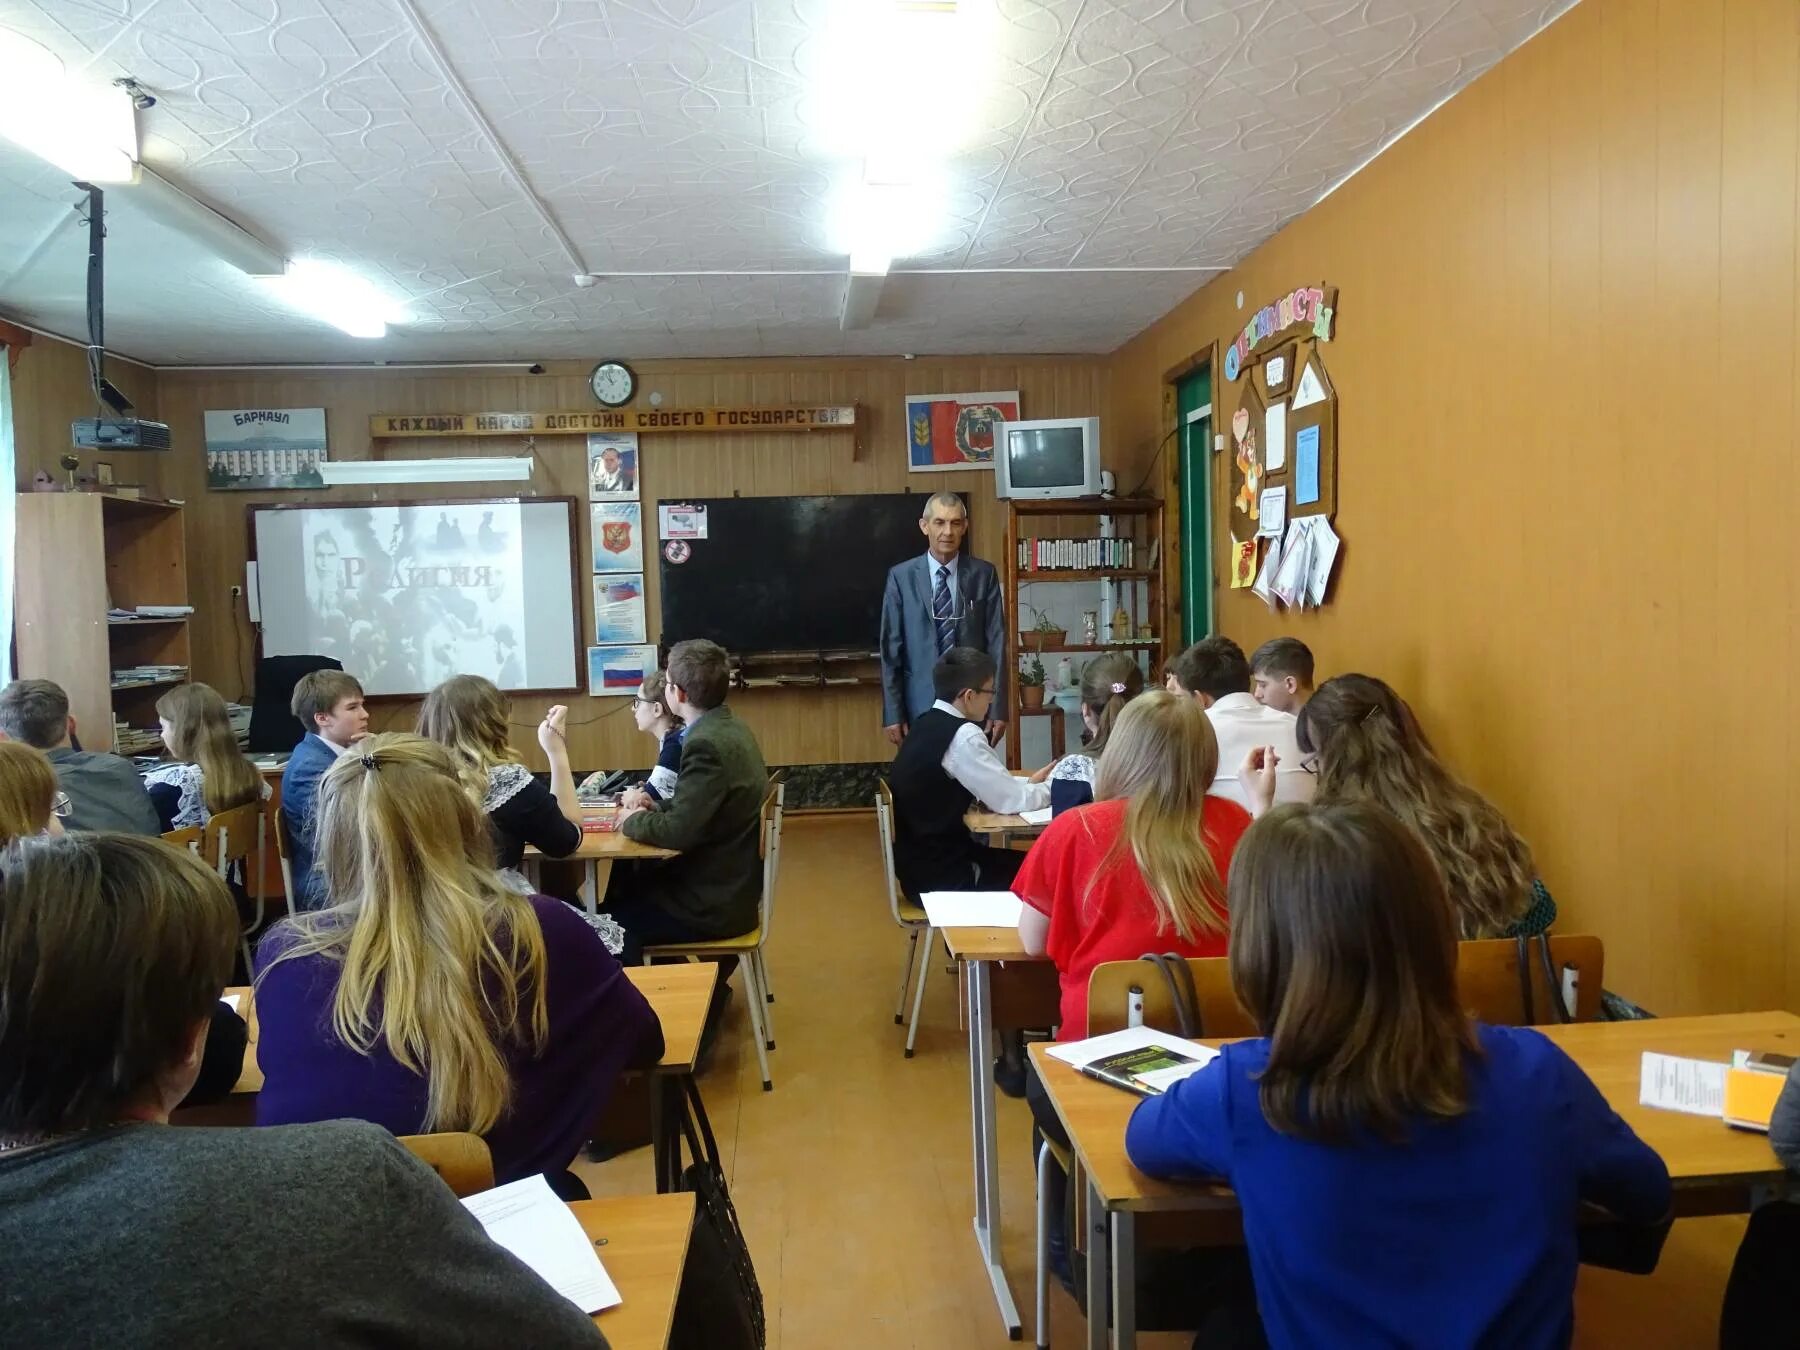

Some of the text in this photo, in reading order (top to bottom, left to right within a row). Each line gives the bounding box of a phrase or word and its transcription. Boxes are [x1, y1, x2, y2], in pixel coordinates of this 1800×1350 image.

[1225, 287, 1333, 381] ОПТИМИСТЫ
[233, 411, 291, 427] БАРНАУЛ
[475, 414, 534, 430] НАРОД
[638, 411, 705, 427] СВОЕГО
[716, 408, 840, 426] ГОСУДАРСТВА
